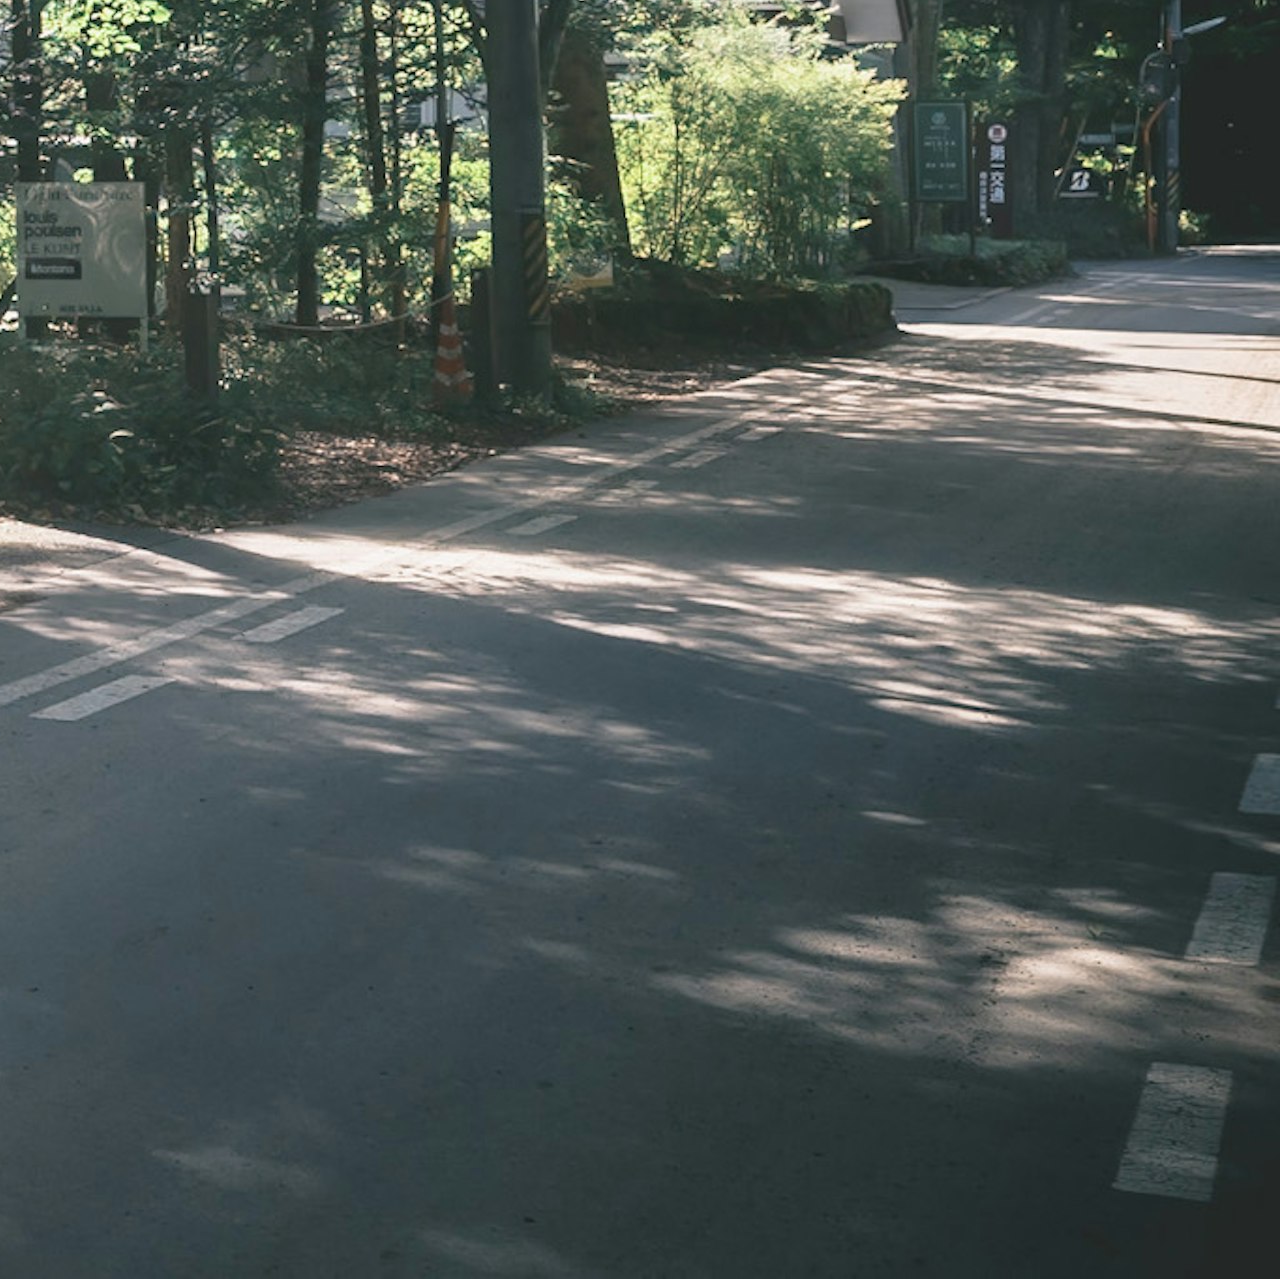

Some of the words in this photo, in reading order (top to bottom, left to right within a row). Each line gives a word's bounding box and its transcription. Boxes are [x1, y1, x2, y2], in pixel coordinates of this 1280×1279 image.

[990, 144, 1005, 204] 第一交通
[24, 210, 58, 224] louis
[24, 223, 82, 240] poulsen
